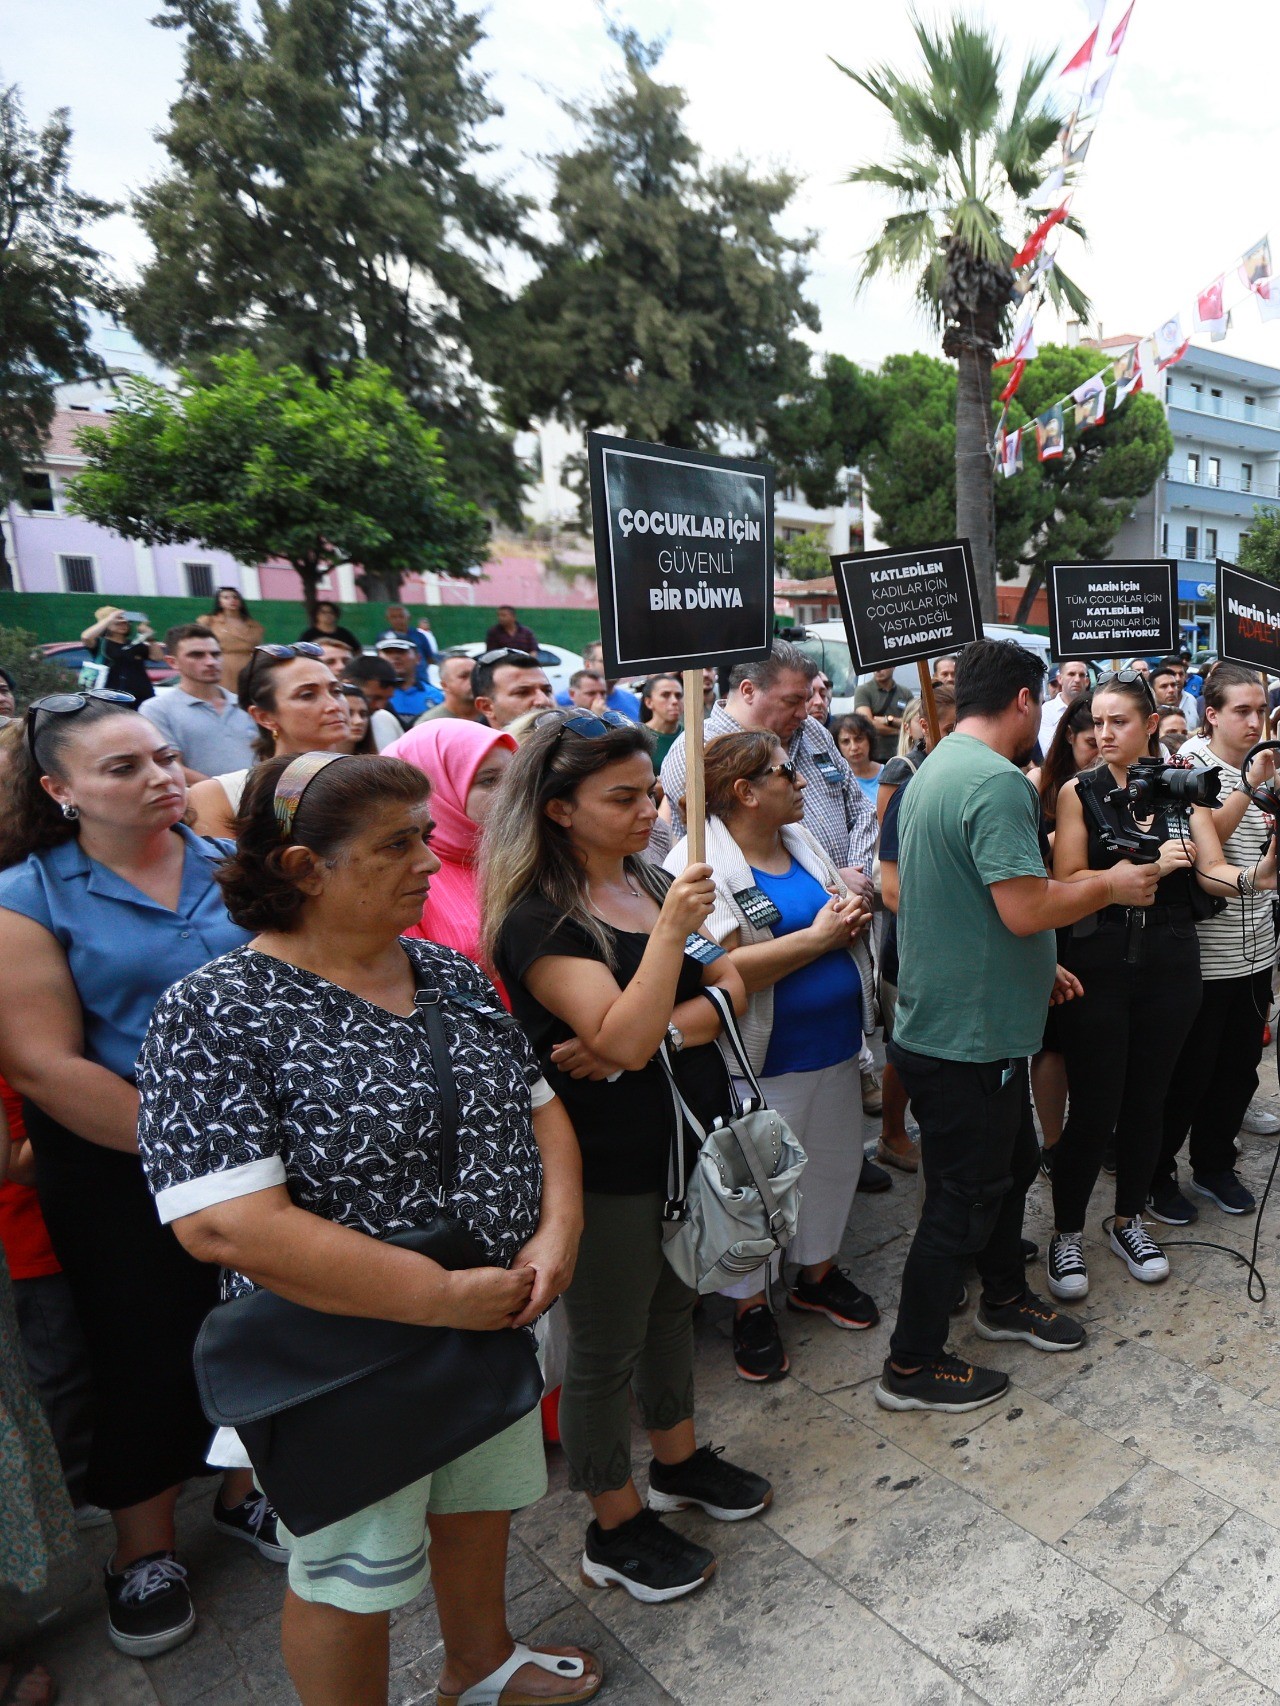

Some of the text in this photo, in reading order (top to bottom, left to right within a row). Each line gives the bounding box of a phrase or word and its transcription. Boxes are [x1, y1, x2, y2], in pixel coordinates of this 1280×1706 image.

[618, 508, 761, 545] ÇOCUKLAR İÇİN
[658, 546, 734, 574] GÜVENLİ
[870, 561, 944, 583] KATLEDİLEN
[649, 580, 743, 611] BİR DÜNYA
[871, 577, 948, 600] KADILAR İÇİN
[1088, 580, 1140, 593] NARİN İÇİN
[866, 592, 958, 621] ÇOCUKLAR İÇİN
[1065, 592, 1162, 605] TÜM ÇOCUKLAR İÇİN
[879, 609, 952, 633] YASTA DEĞİL
[1070, 616, 1160, 628] TÜM KADINLAR İÇİN
[1086, 605, 1144, 616] KATLEDİLEN
[1228, 598, 1265, 623] Narin
[883, 626, 953, 649] İSYANDAYIZ
[1072, 628, 1160, 640] ADALET İSTİYORUZ
[1238, 617, 1280, 647] ADALET
